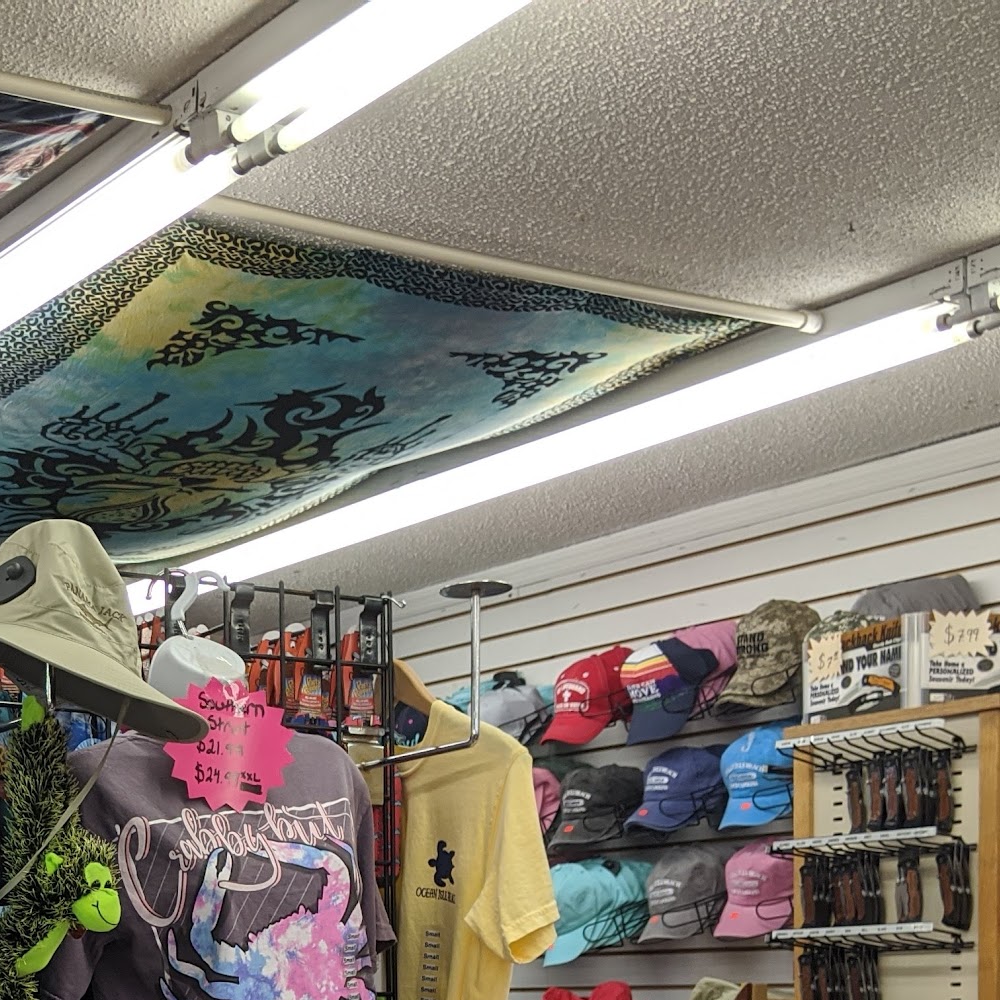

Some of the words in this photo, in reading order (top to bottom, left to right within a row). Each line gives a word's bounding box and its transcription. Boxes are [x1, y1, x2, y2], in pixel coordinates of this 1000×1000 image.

[99, 606, 127, 624] JACK
[737, 630, 765, 646] TAND
[856, 652, 878, 671] YOUR
[257, 801, 344, 846] but
